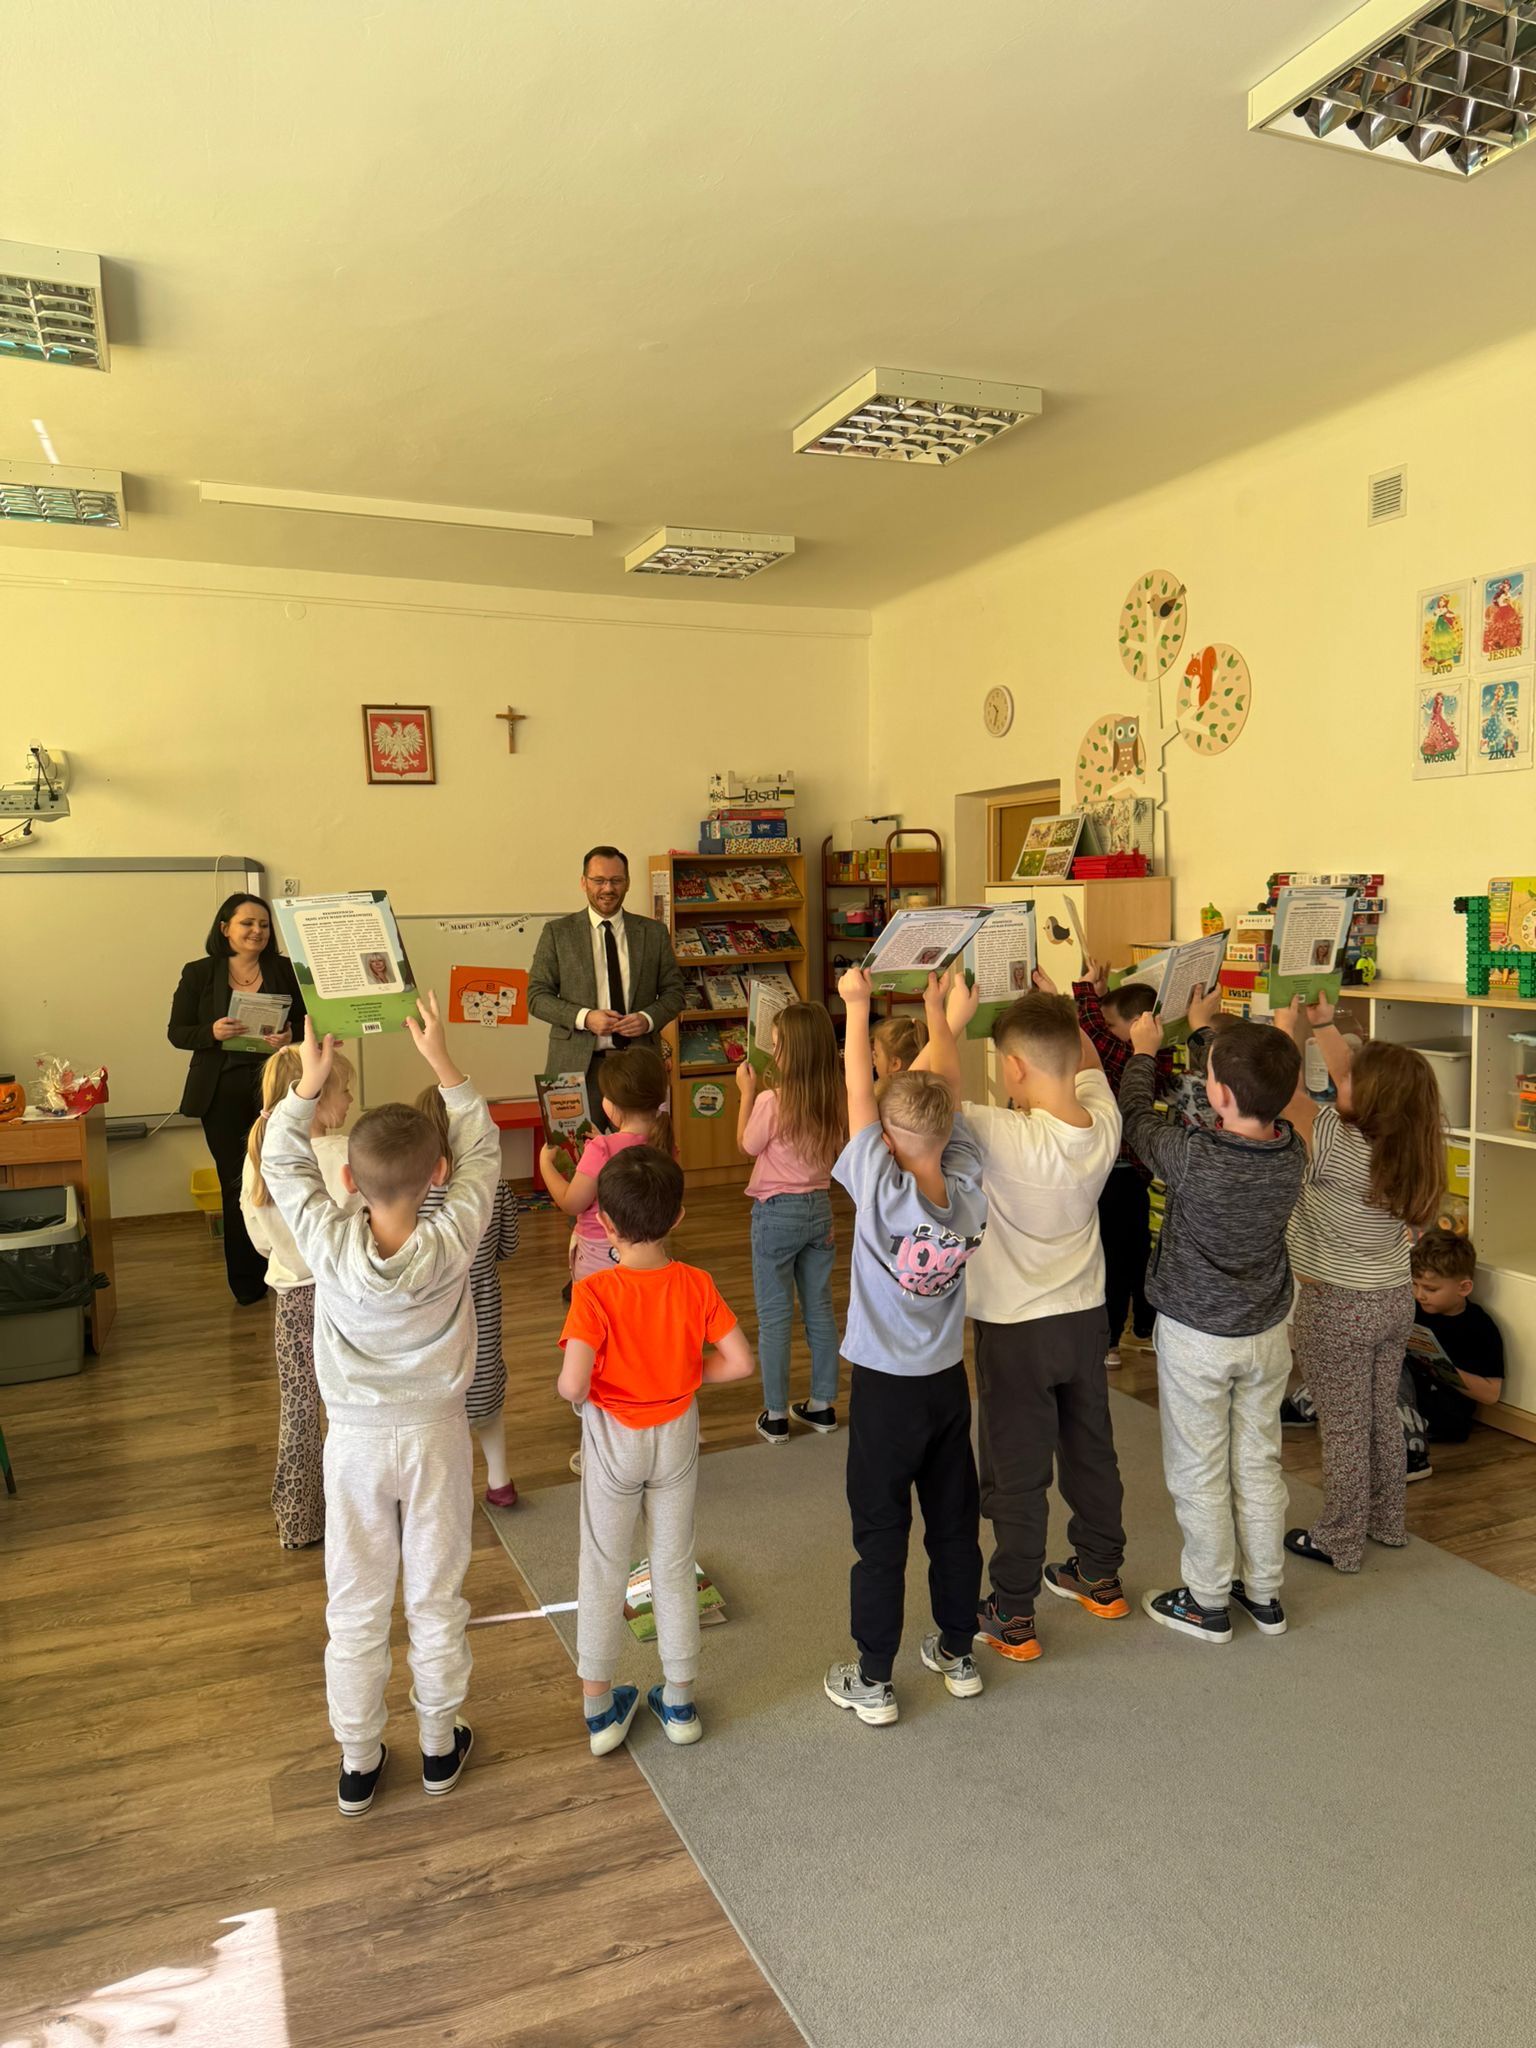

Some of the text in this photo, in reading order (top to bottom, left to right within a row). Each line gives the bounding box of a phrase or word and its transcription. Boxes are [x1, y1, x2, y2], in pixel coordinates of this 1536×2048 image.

[1432, 664, 1453, 676] LATO
[1423, 753, 1456, 764] WIOSNA
[1488, 750, 1516, 761] ZIMA
[843, 1676, 852, 1691] N
